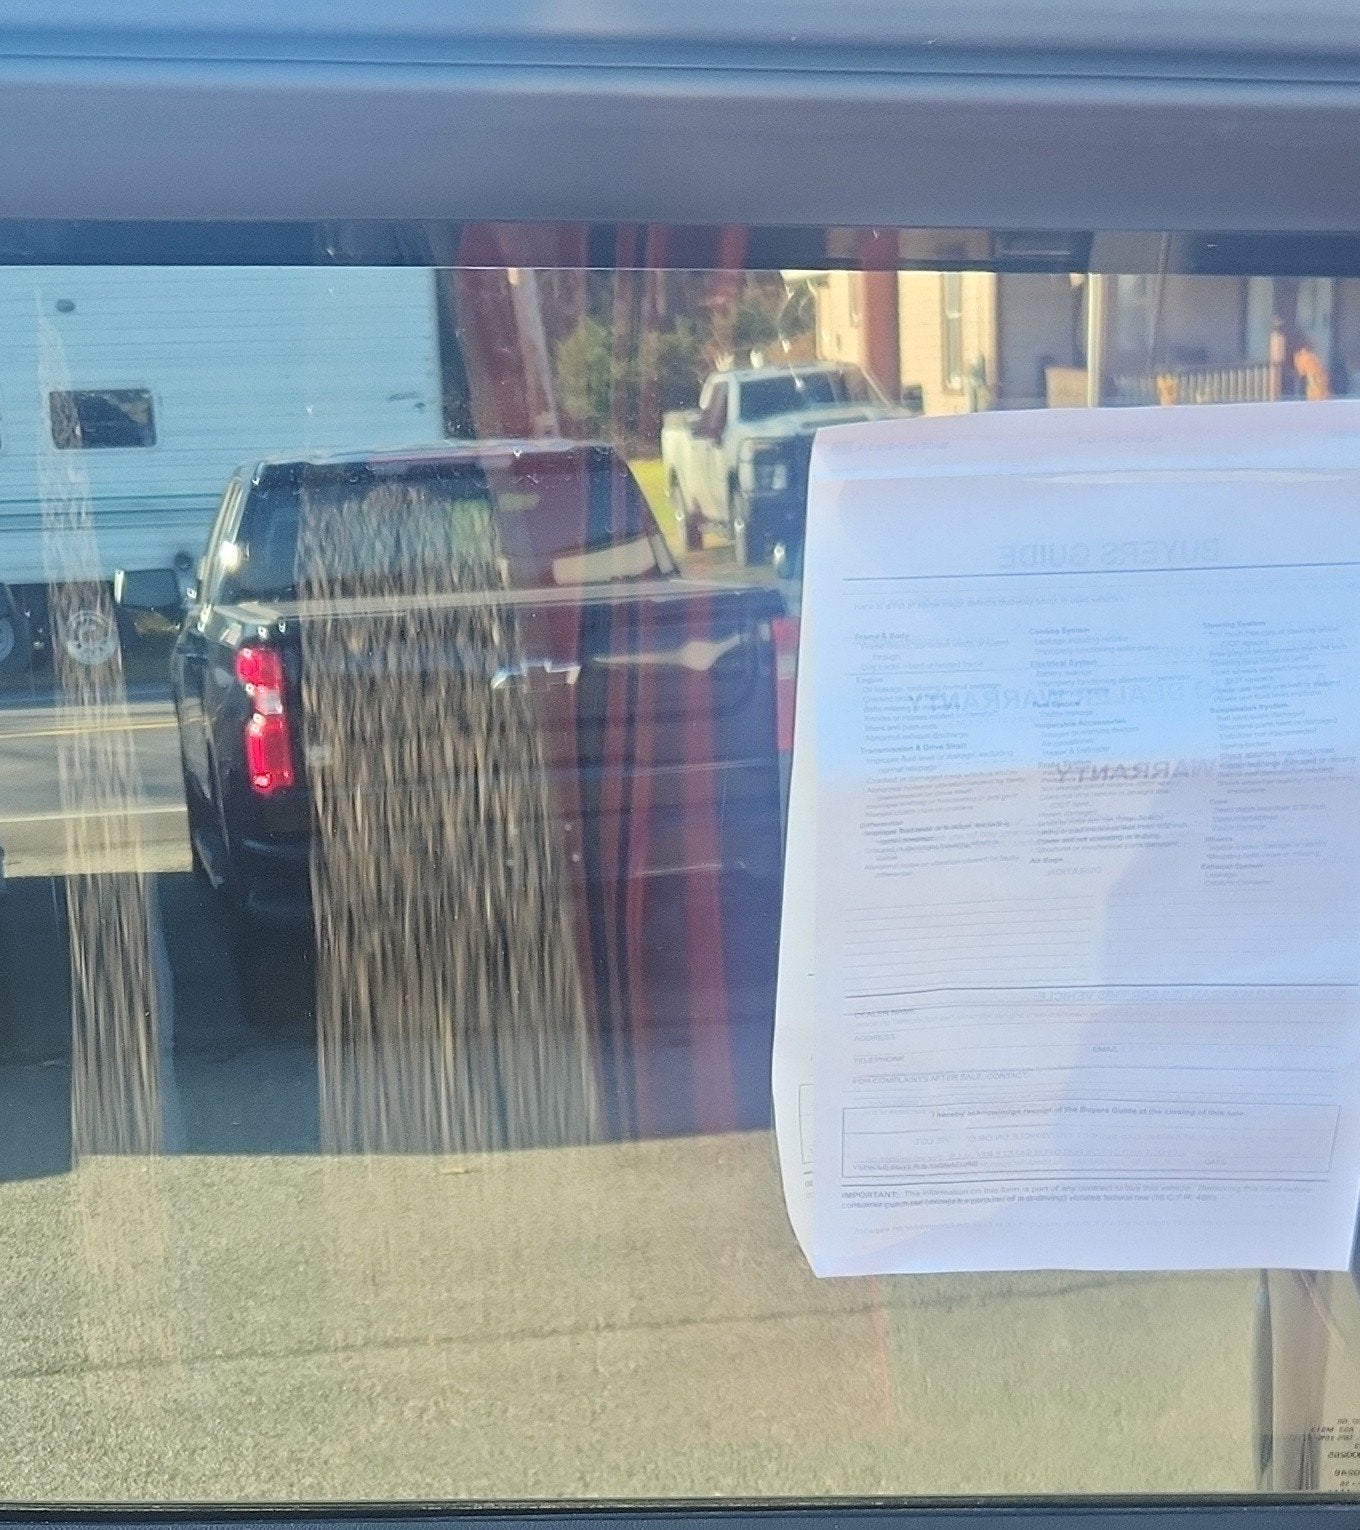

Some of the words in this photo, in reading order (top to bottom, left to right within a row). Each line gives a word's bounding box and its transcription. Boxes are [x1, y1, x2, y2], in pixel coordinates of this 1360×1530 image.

[860, 746, 913, 754] Transmission
[945, 742, 967, 750] Shaft
[853, 1034, 896, 1042] ADDRESS
[853, 1056, 905, 1064] TELEPHONE
[873, 1075, 929, 1084] COMPLAINTS
[930, 1074, 959, 1083] AFTER
[1080, 1106, 1110, 1115] Buyers
[1111, 1106, 1138, 1114] Guide
[842, 1190, 899, 1199] IMPORTANT:
[922, 1188, 969, 1196] information
[983, 1186, 999, 1194] this
[1000, 1186, 1020, 1194] form
[1031, 1185, 1049, 1194] part
[1061, 1186, 1076, 1194] any
[1078, 1184, 1113, 1192] contract
[1125, 1184, 1141, 1194] buy
